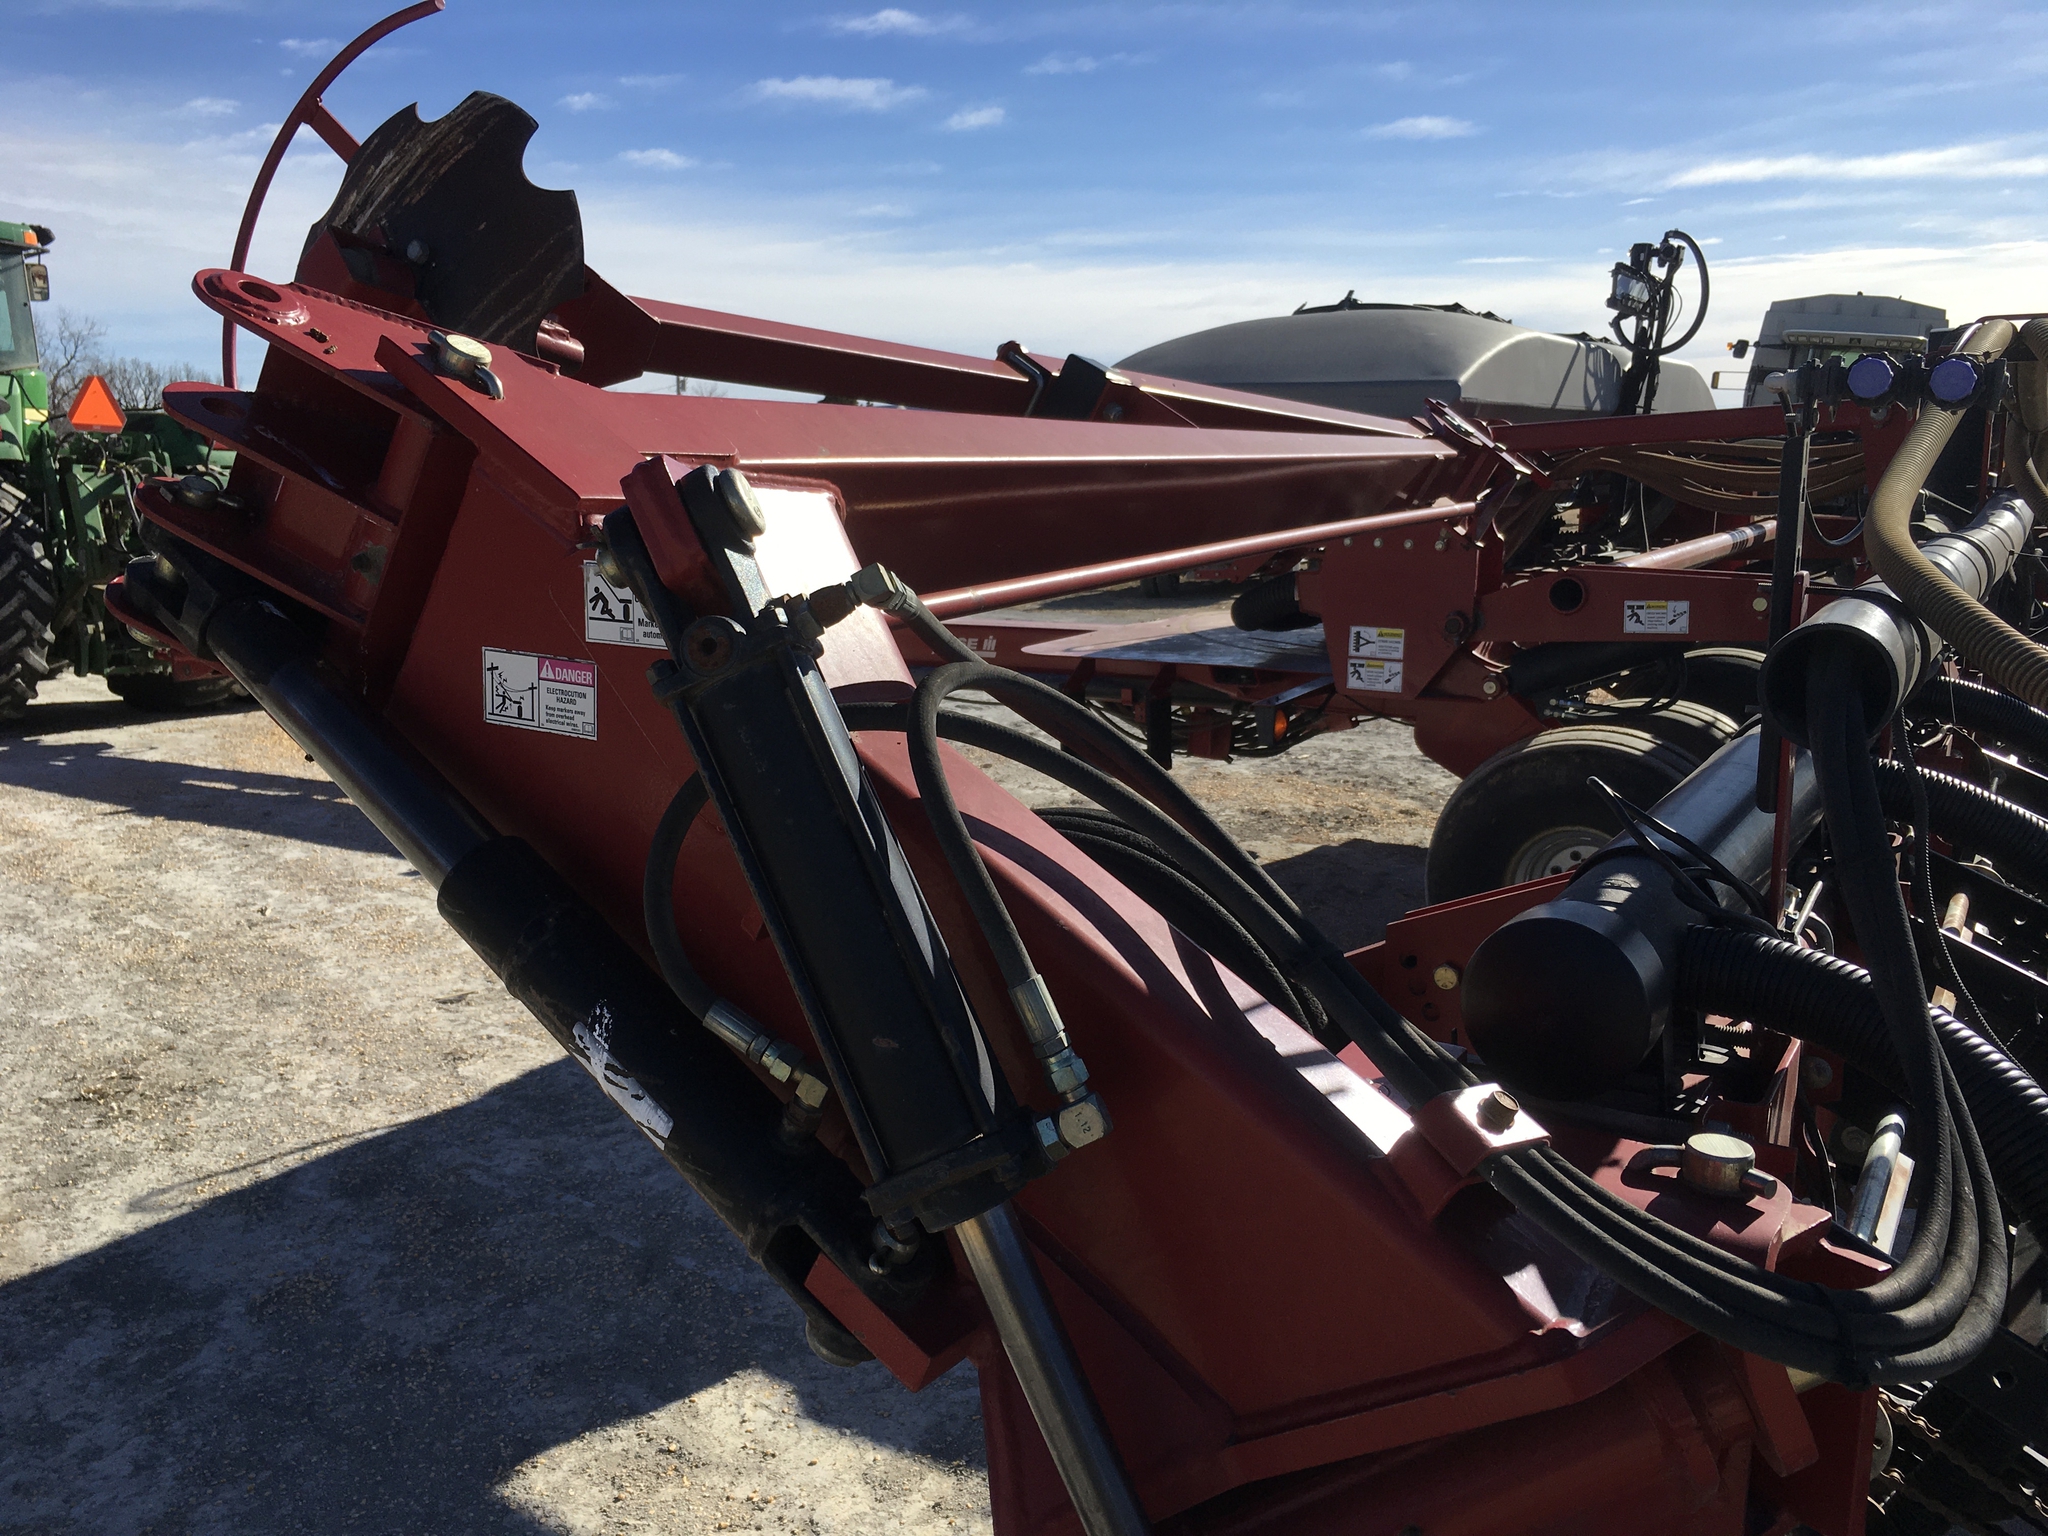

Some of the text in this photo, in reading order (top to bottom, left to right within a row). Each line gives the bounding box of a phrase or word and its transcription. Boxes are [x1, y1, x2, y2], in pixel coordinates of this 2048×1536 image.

[642, 631, 663, 640] autom
[555, 667, 593, 685] DANGER
[546, 687, 587, 699] ELECTROCUTION
[556, 696, 577, 705] HAZARD
[545, 704, 556, 712] Keep
